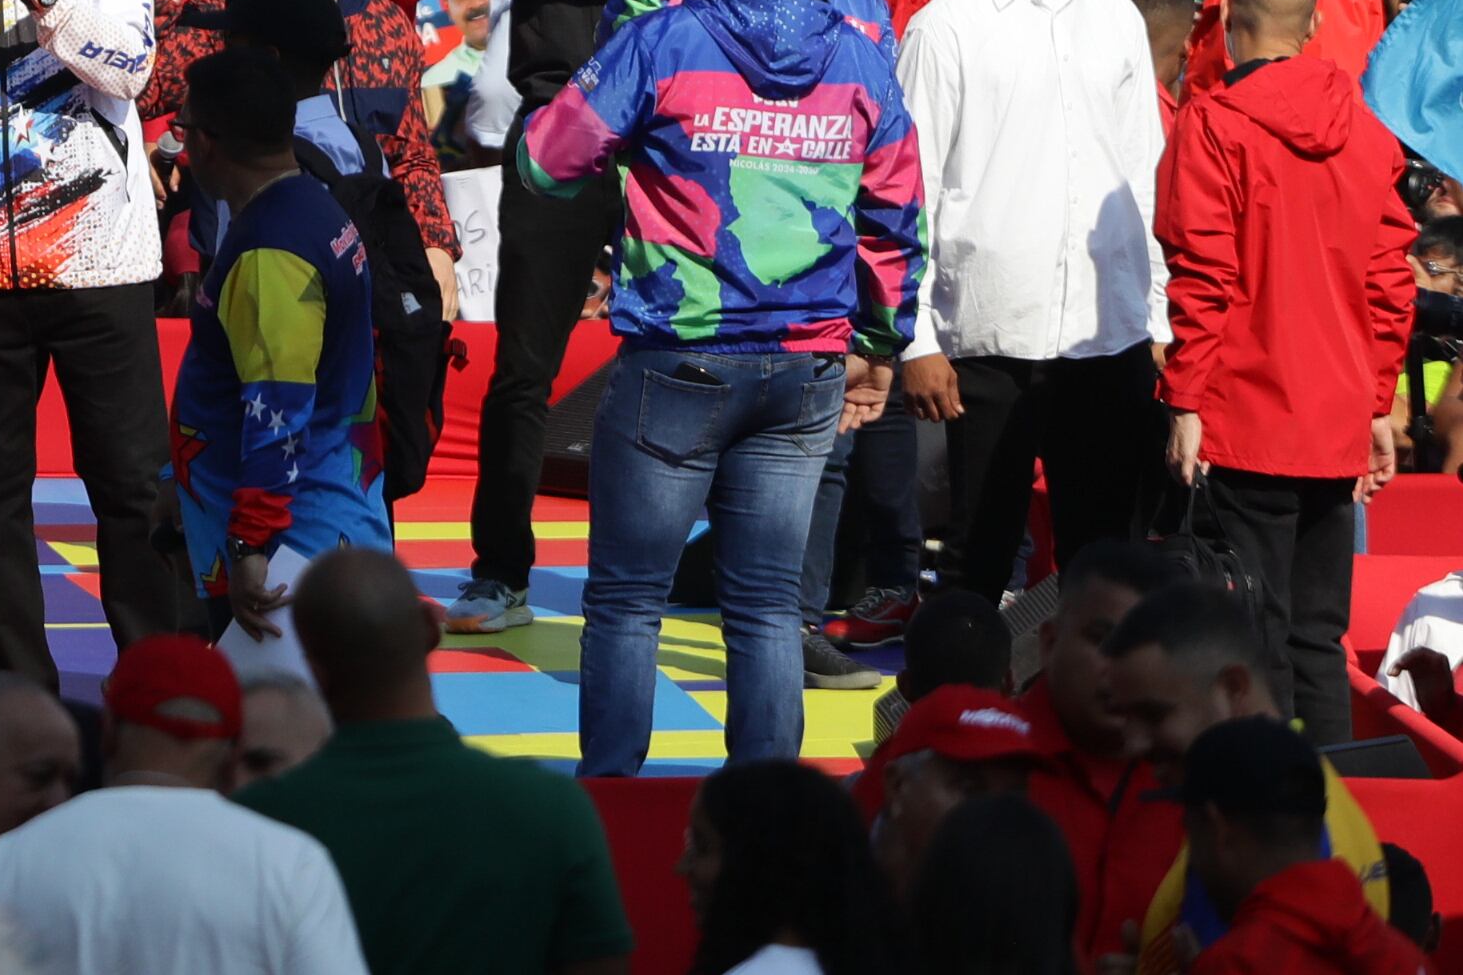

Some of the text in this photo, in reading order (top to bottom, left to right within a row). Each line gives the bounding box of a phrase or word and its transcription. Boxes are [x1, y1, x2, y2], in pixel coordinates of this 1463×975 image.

[694, 106, 853, 140] LA ESPERANZA
[690, 132, 742, 153] ESTÁ
[747, 136, 773, 155] EN
[801, 139, 853, 160] CALLE
